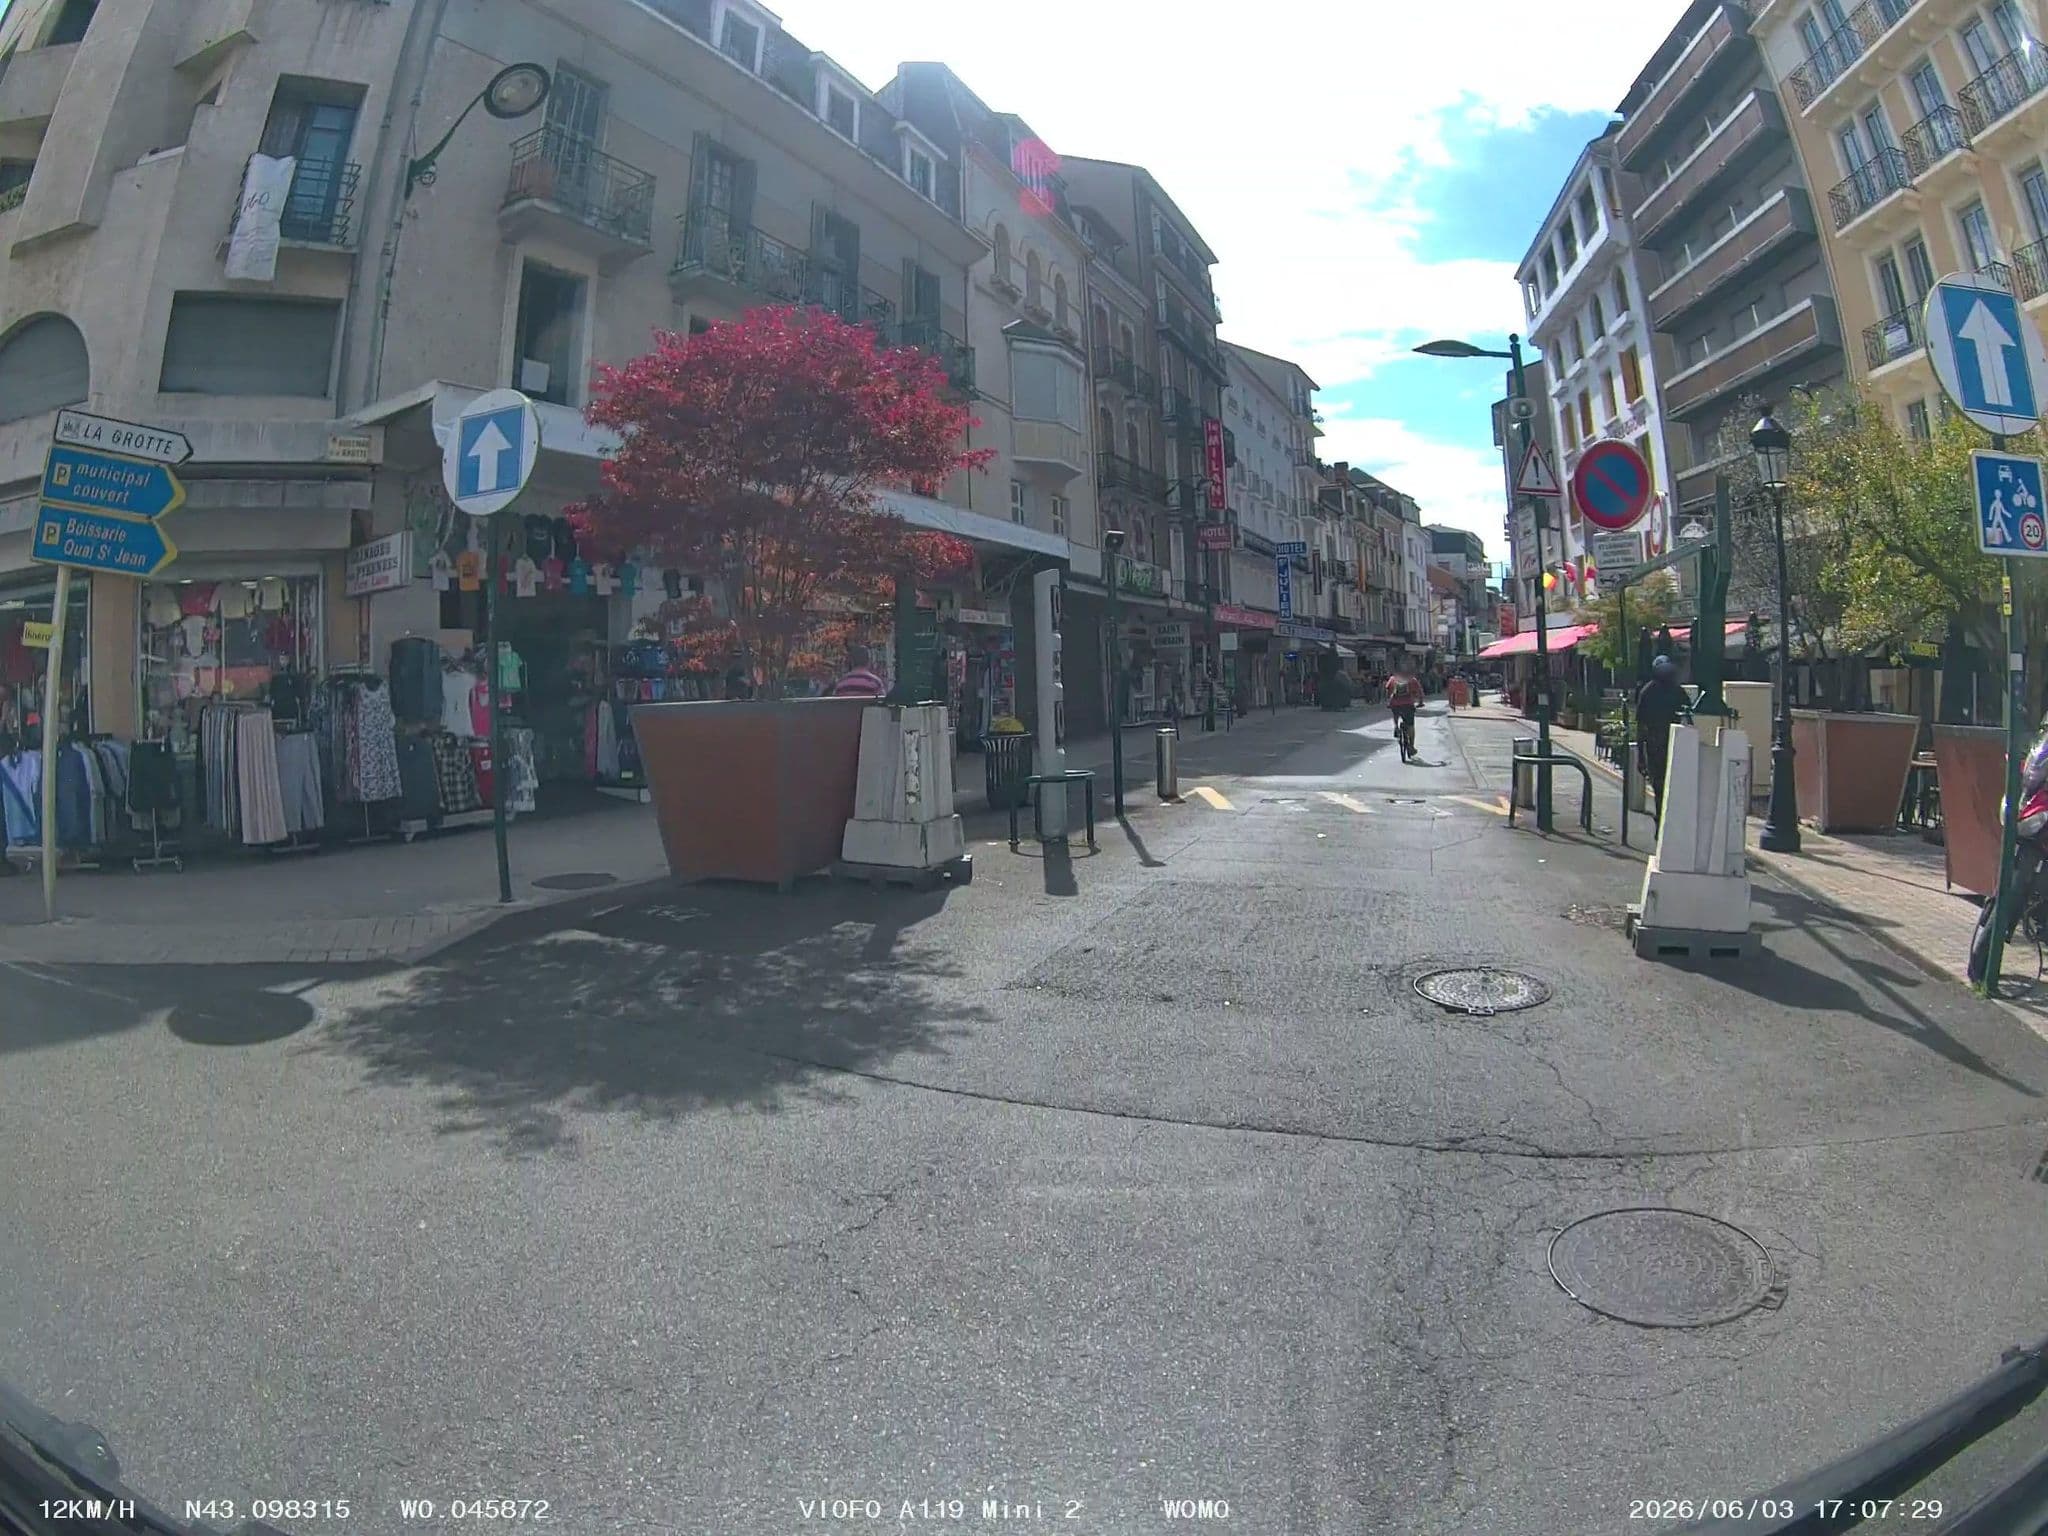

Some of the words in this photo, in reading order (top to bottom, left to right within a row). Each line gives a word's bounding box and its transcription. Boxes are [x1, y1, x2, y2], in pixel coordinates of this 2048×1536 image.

[83, 423, 102, 440] LA
[111, 429, 173, 455] GROTTE
[75, 463, 150, 487] municipal
[73, 482, 130, 505] couvert
[65, 517, 127, 543] Boissarie
[2025, 523, 2040, 538] 20
[63, 538, 94, 560] Quai
[114, 549, 146, 567] Jean
[1278, 543, 1304, 554] HOTEL
